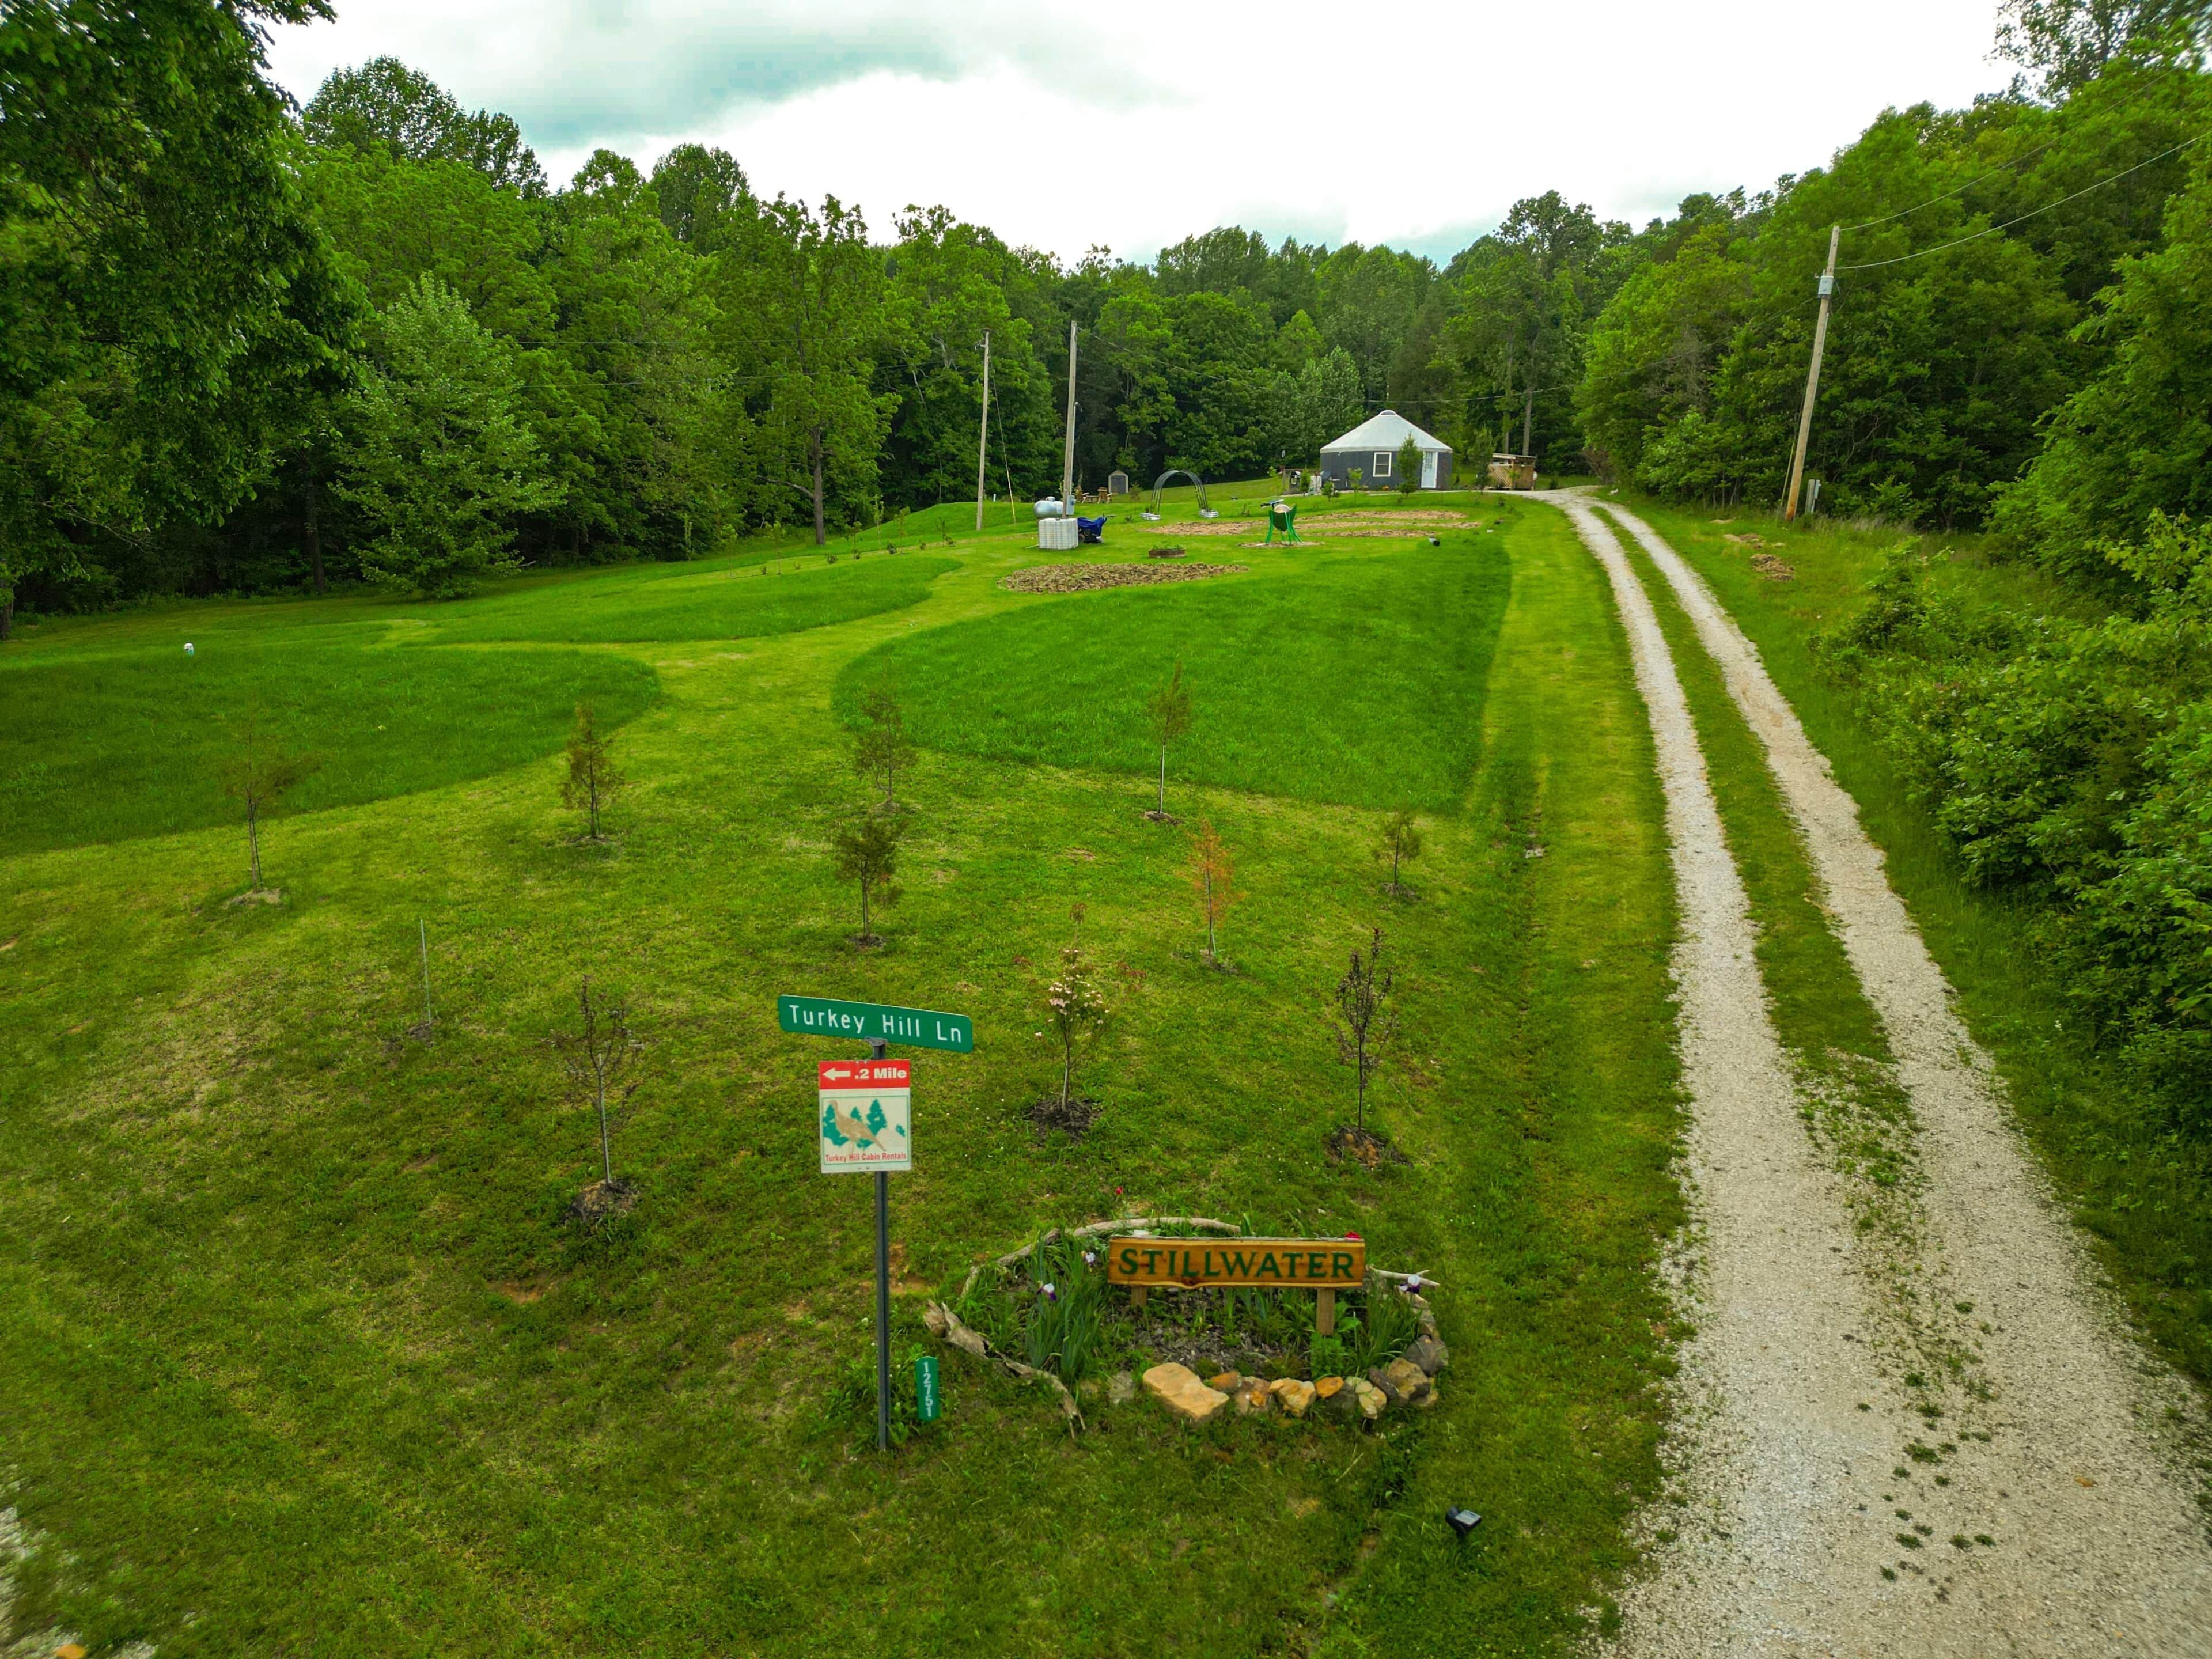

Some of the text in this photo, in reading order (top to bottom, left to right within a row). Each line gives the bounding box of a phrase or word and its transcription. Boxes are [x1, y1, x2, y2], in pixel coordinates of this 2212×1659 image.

[789, 1005, 961, 1043] Turkey Hill Ln
[854, 1067, 907, 1080] .2 Mile
[825, 1154, 847, 1162] Turkey
[1118, 1248, 1354, 1278] STILLWATER
[923, 1361, 933, 1417] 12751
